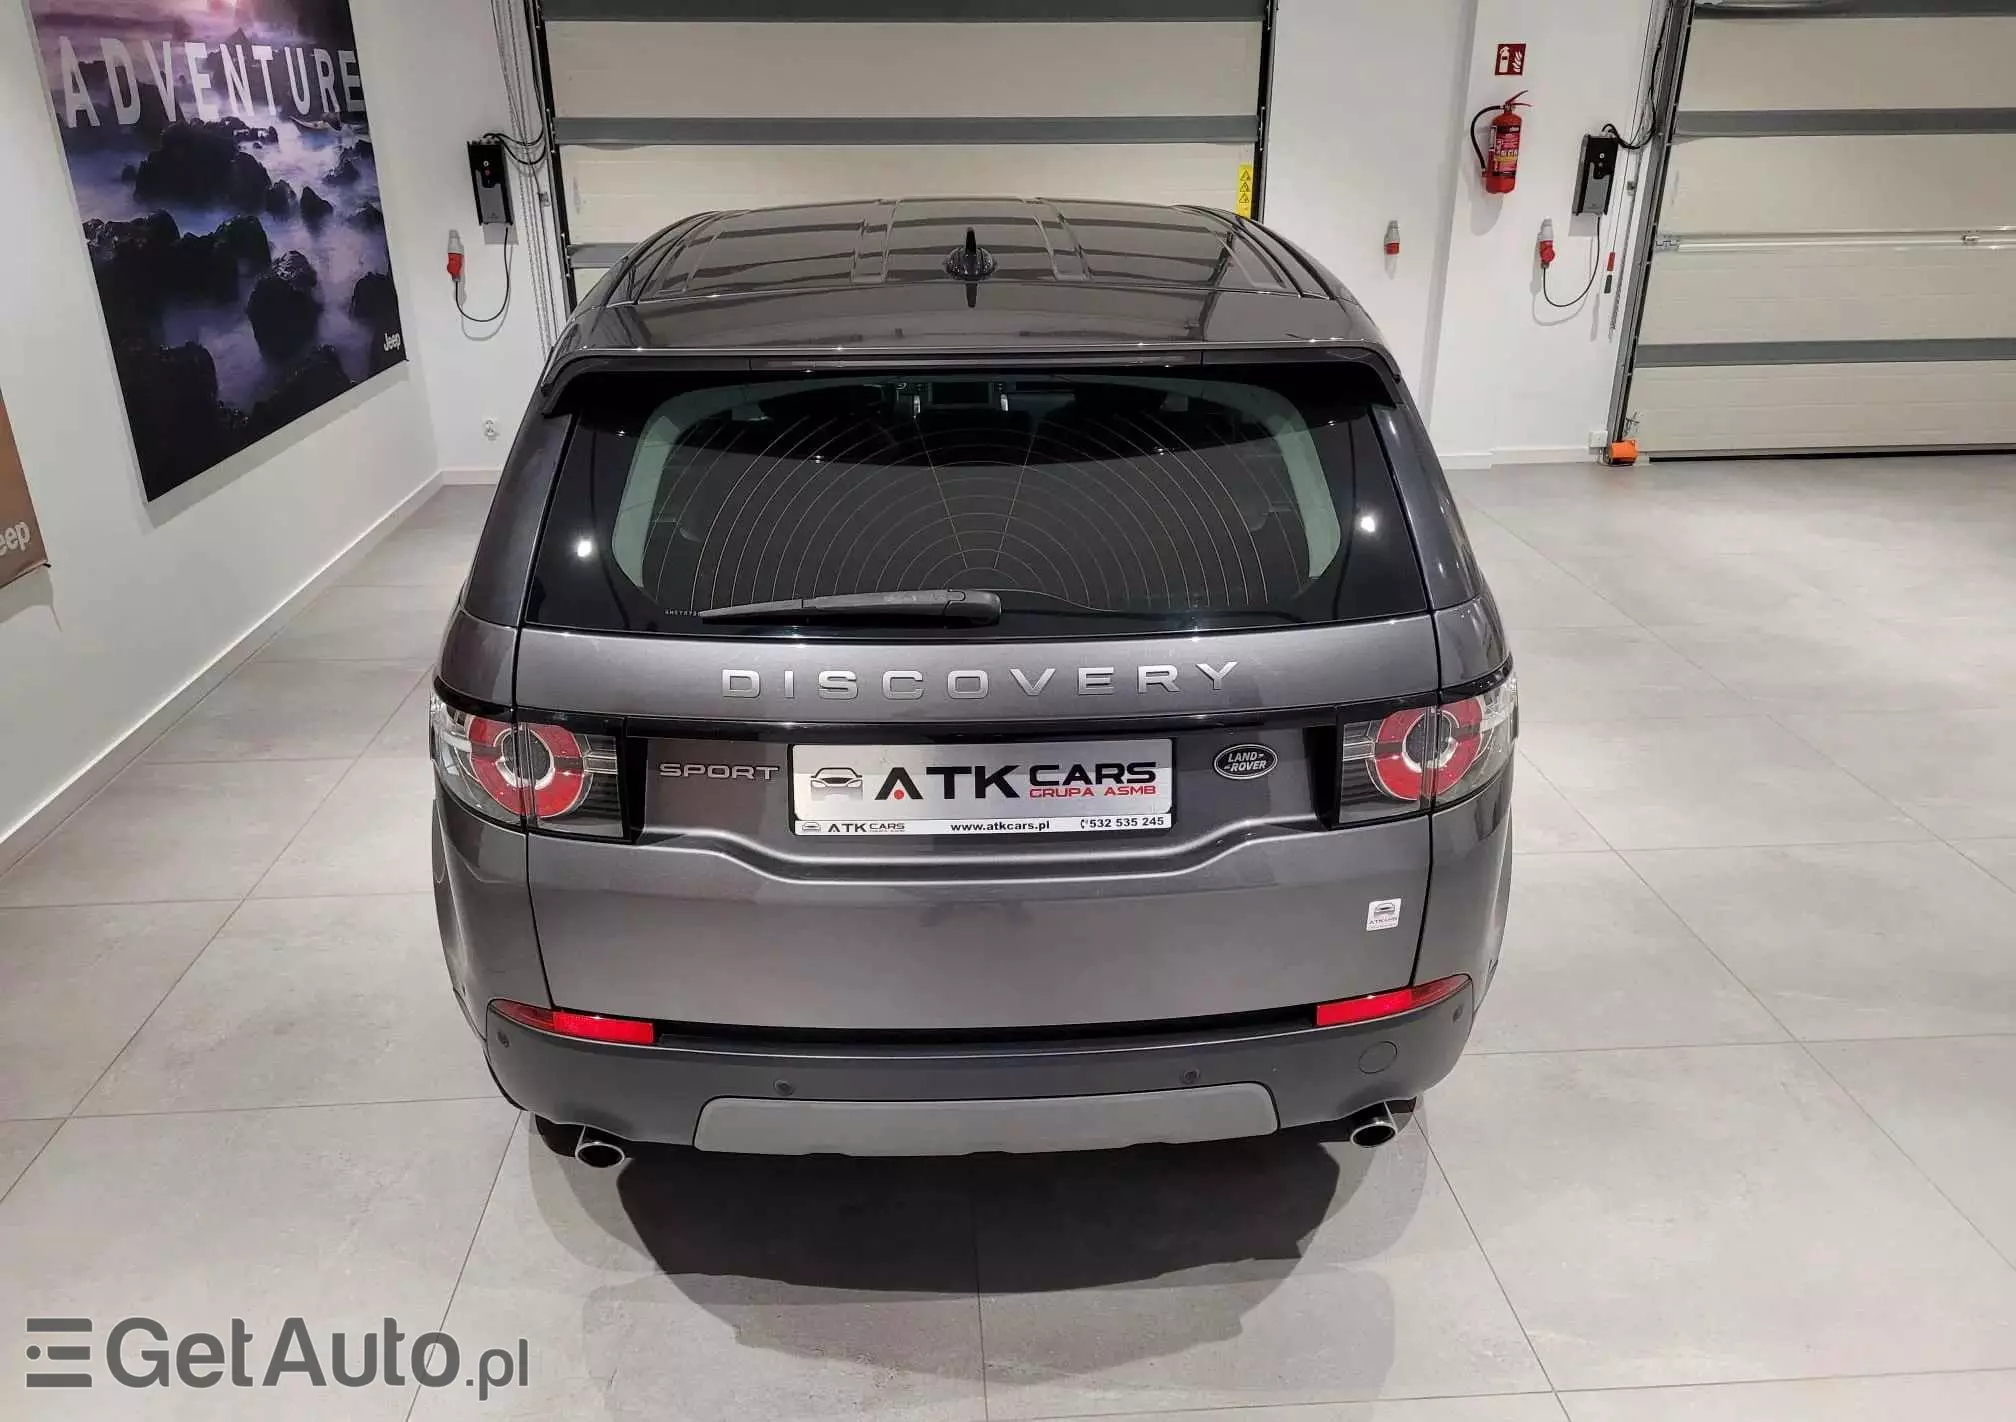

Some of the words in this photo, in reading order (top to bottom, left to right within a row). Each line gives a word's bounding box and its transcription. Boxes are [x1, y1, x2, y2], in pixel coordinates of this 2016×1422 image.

[59, 35, 365, 128] ADVENTURE
[384, 332, 400, 352] Jeep
[0, 521, 31, 556] eep
[721, 660, 1239, 699] DISCOVERY
[659, 763, 779, 780] SPORT
[874, 765, 1021, 801] ATK
[1029, 762, 1157, 786] CARS
[1029, 787, 1094, 799] GRUPA
[1104, 785, 1157, 796] ASMB
[828, 823, 867, 833] ATK
[951, 820, 1050, 832] www.atkcars.pl
[1089, 819, 1112, 828] 532
[1116, 818, 1138, 828] 535
[1142, 816, 1164, 827] 245
